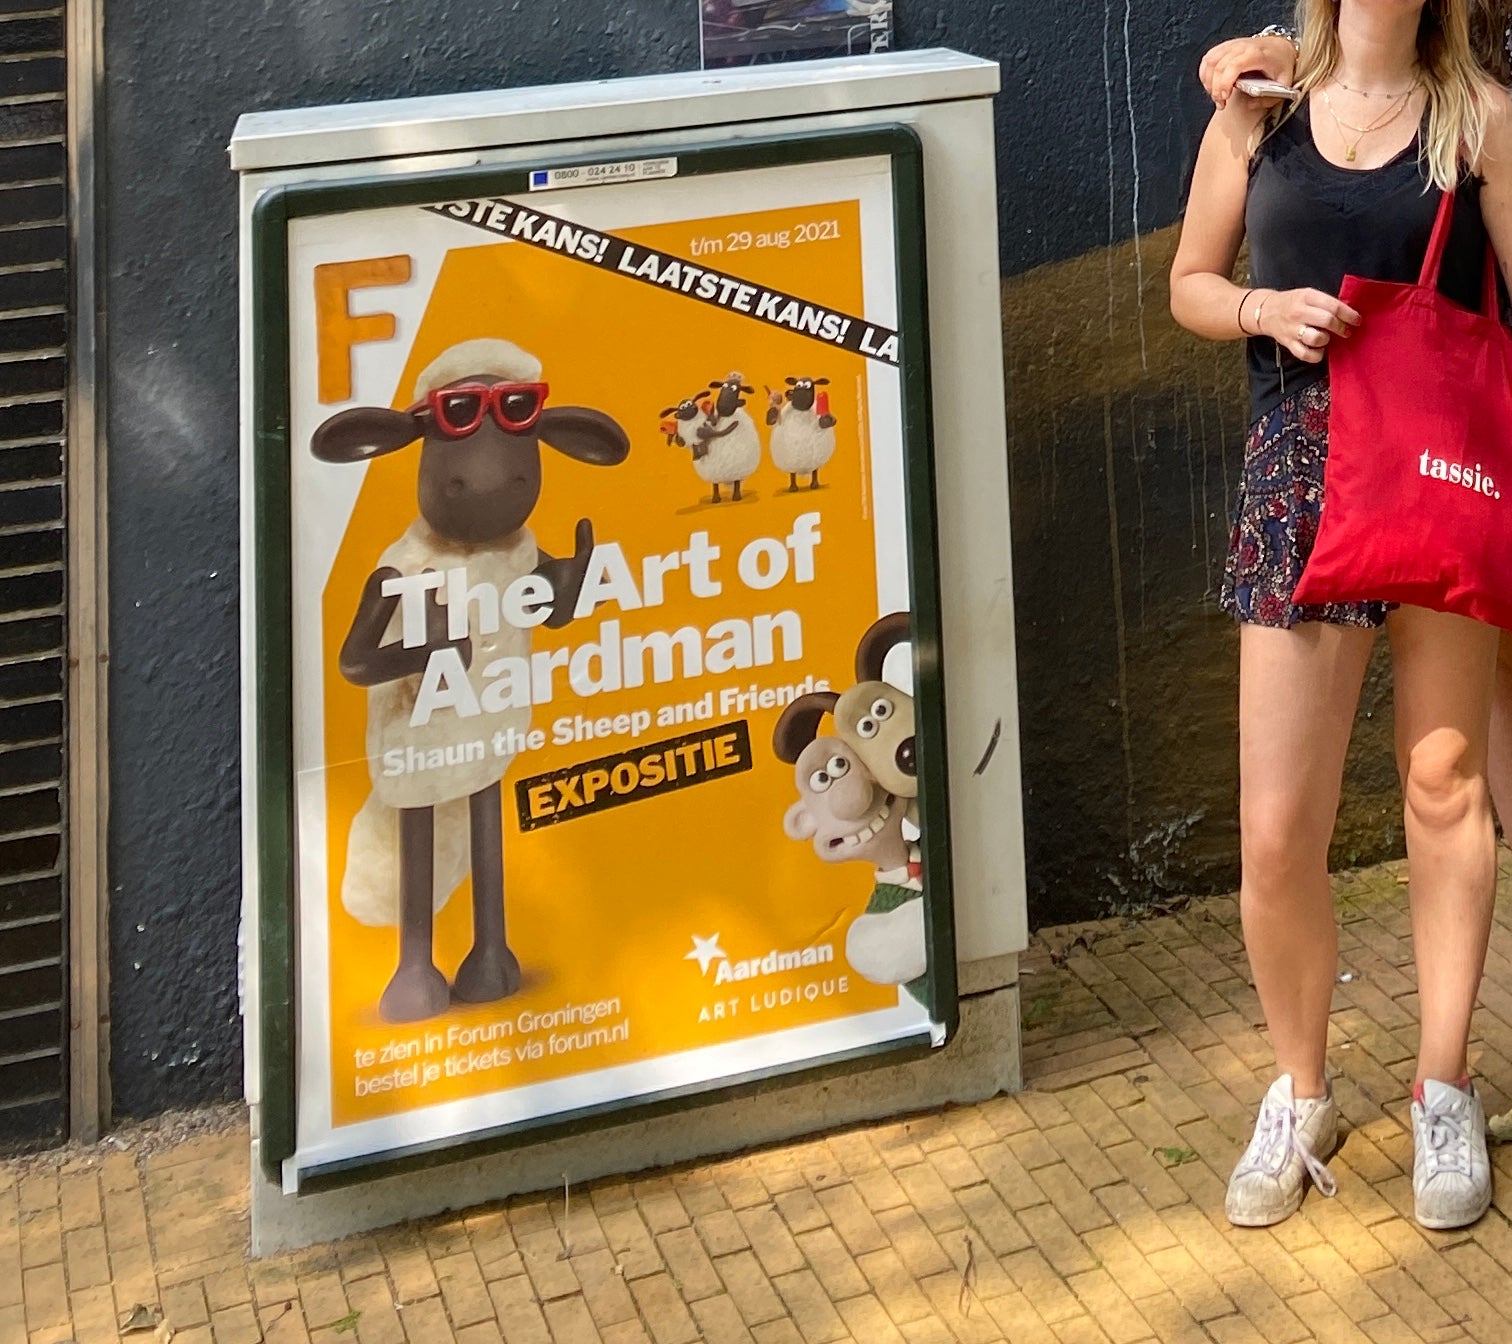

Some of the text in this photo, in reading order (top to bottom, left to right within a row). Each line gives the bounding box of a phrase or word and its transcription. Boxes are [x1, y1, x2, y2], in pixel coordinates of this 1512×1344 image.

[511, 211, 611, 263] KANS!
[617, 245, 757, 313] LAATSTE
[755, 292, 850, 344] KANS!
[690, 220, 841, 256] t/m 29 aug 2021
[314, 254, 412, 405] F
[1419, 448, 1501, 500] tassie.
[381, 511, 821, 650] The Art of
[408, 609, 803, 728] Aardman
[382, 734, 486, 778] Shaun
[491, 728, 545, 757] the
[552, 708, 653, 746] Sheep
[656, 692, 713, 726] and
[527, 732, 742, 820] EXPOSITIE
[698, 975, 849, 1023] ART LUDIQUE
[714, 943, 834, 986] Aardman
[354, 997, 621, 1069] te zien in Forum Groningen
[354, 1017, 630, 1098] bestel je tickets via forum.nl
